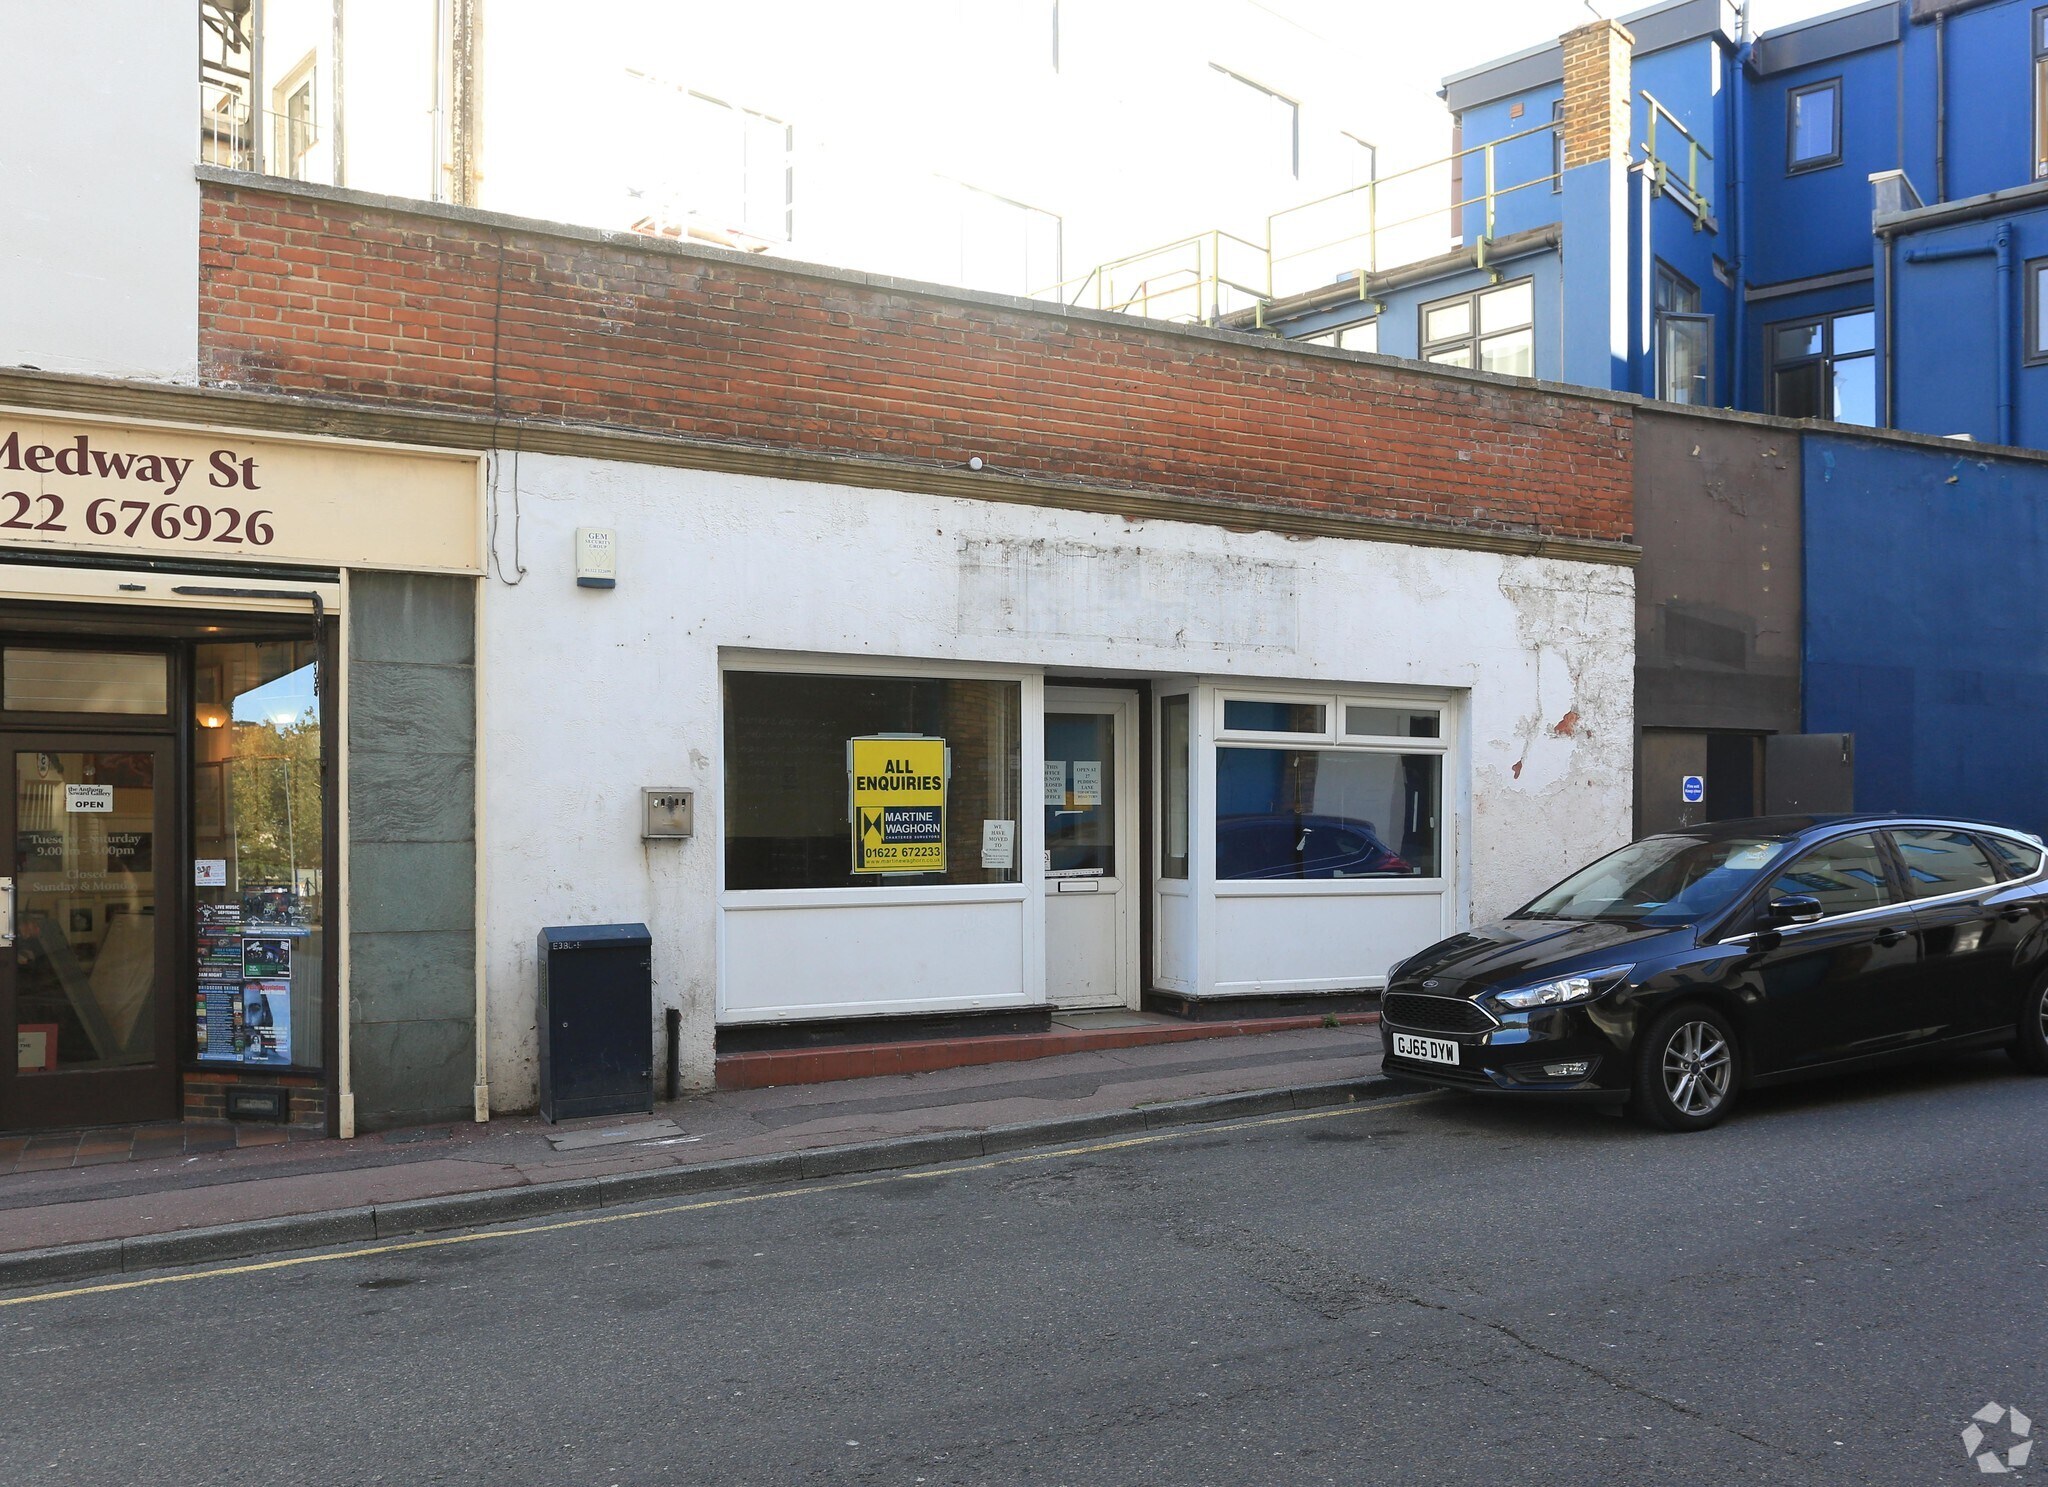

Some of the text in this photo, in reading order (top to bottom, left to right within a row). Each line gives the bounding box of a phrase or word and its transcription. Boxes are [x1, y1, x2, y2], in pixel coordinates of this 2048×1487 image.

[208, 450, 261, 490] St
[86, 498, 274, 545] 676926
[588, 532, 608, 540] GEM
[884, 759, 913, 774] ALL
[856, 775, 942, 791] ENQUIRIES
[885, 811, 933, 822] MARTINE
[885, 823, 941, 834] WAGHORN
[865, 846, 941, 858] 01622 672233
[67, 869, 107, 879] Closed
[33, 882, 77, 893] Sunday
[1398, 1037, 1454, 1061] GJ65 DYW
